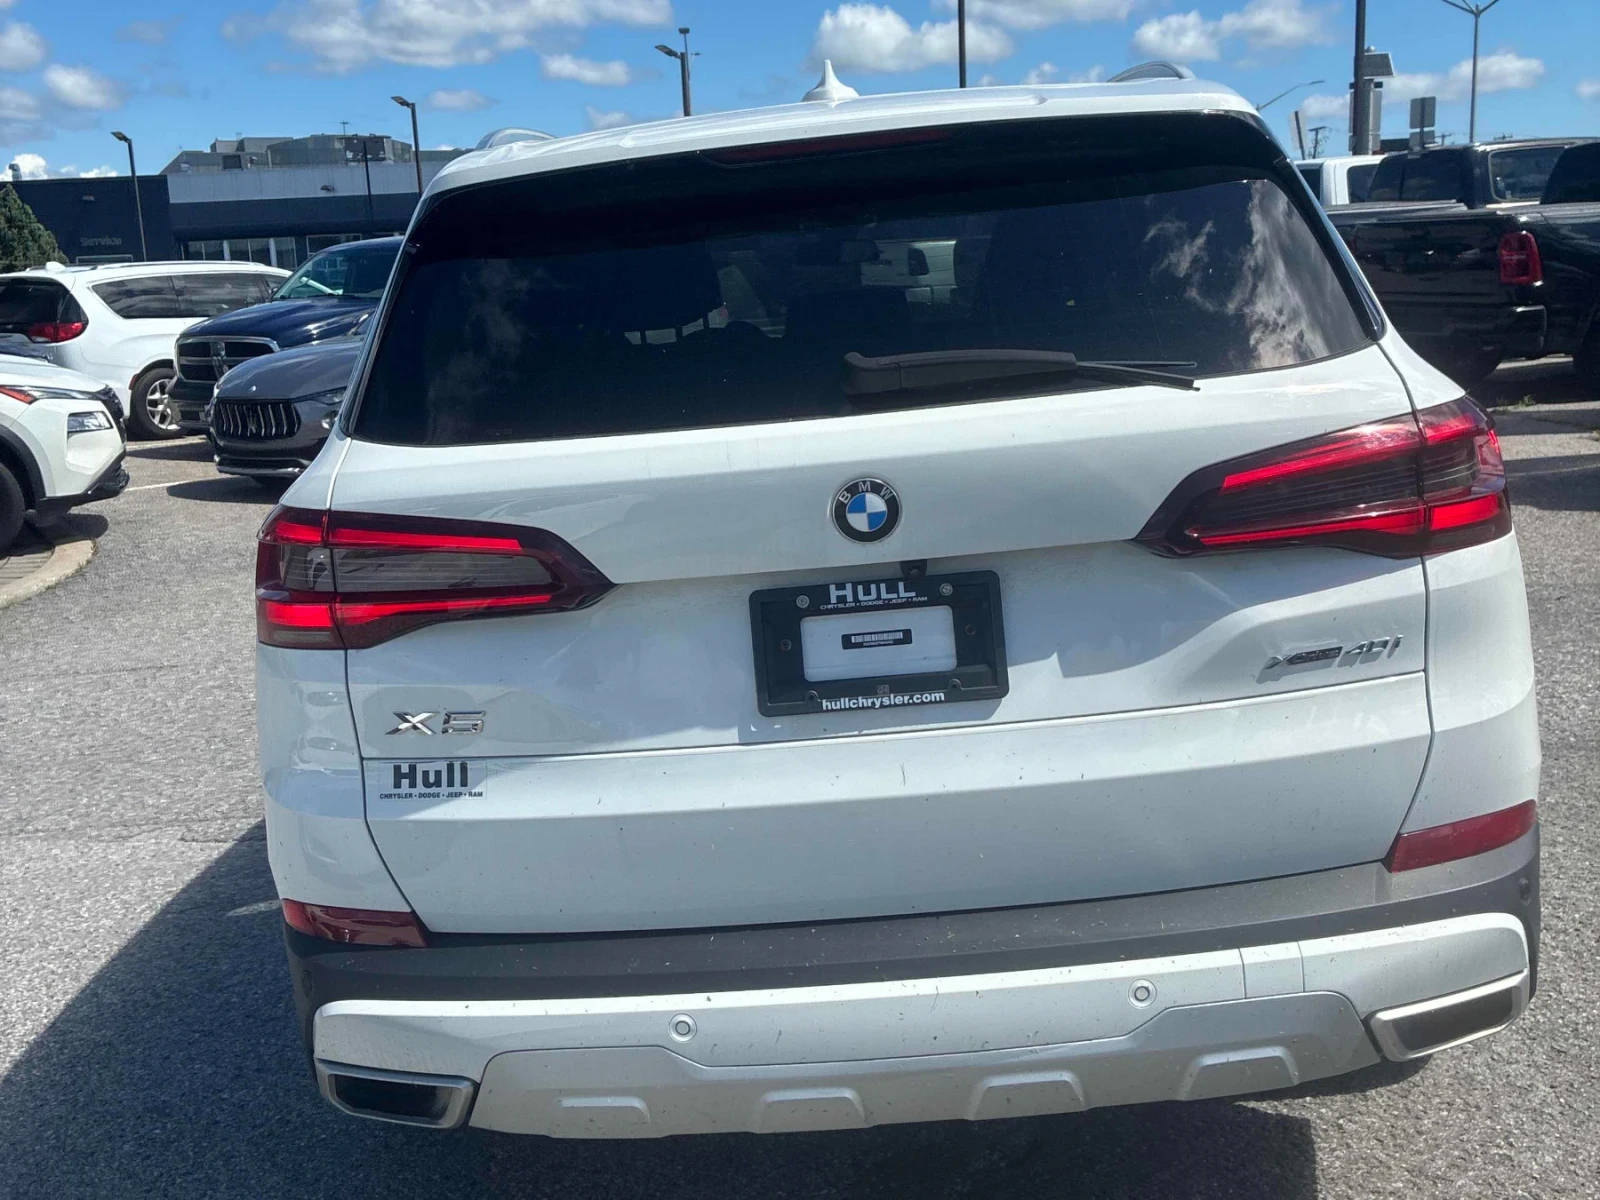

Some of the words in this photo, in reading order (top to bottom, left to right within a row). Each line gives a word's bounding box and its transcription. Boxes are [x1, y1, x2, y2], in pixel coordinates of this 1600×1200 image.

[838, 480, 894, 504] BMW
[820, 602, 856, 610] CHRYSLER
[889, 597, 907, 605] JEEP
[822, 691, 945, 711] hullchrysler.com
[385, 710, 487, 736] X5
[393, 762, 468, 789] Hull
[379, 792, 413, 800] CHRYSLER
[467, 790, 484, 798] RAM
